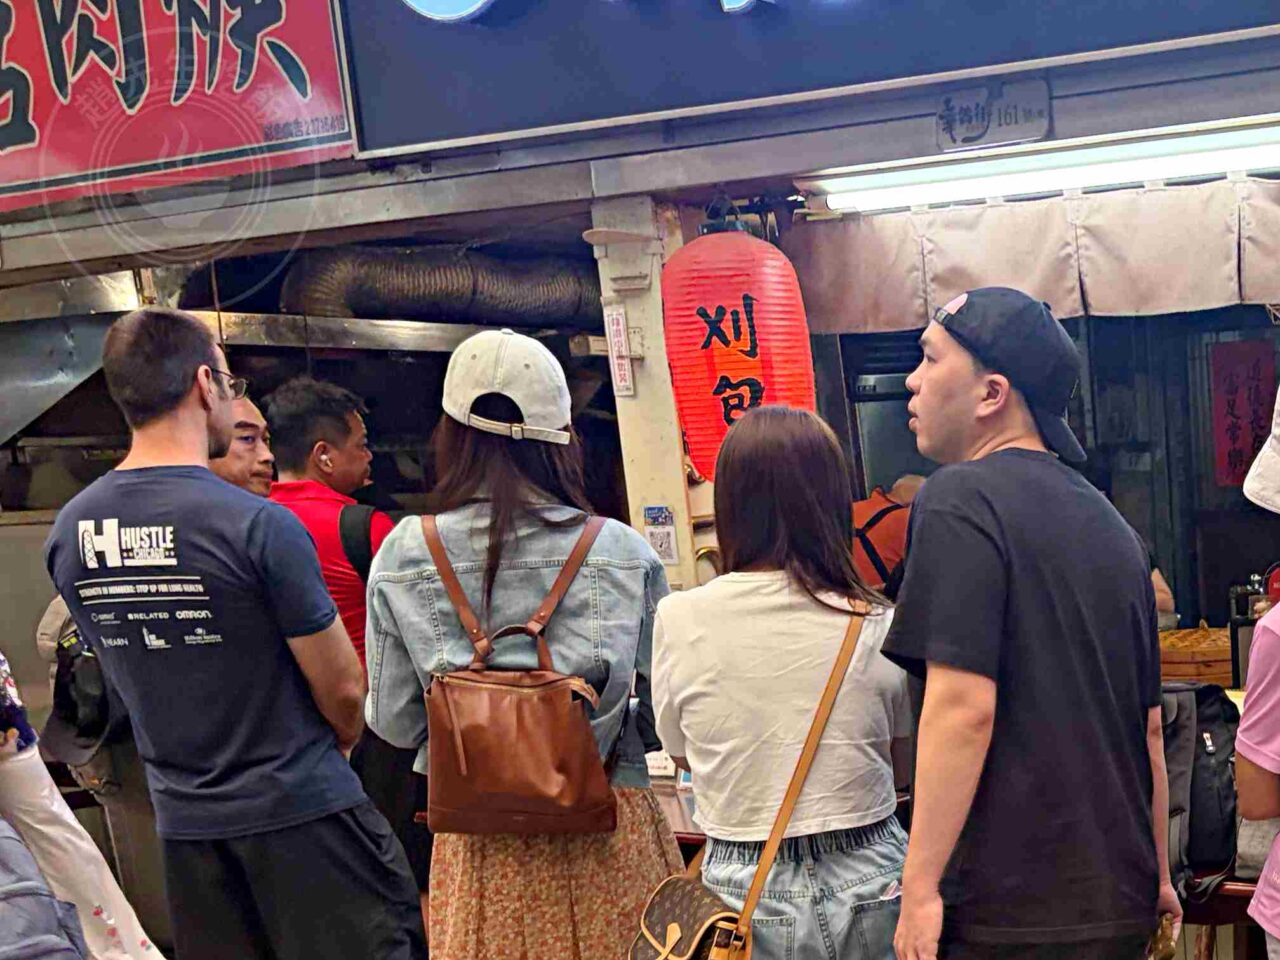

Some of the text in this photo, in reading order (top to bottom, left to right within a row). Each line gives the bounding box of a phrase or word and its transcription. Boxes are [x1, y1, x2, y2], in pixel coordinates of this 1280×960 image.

[696, 293, 766, 428] 刈包
[120, 526, 174, 549] HUSTLE
[134, 612, 170, 620] RELATED
